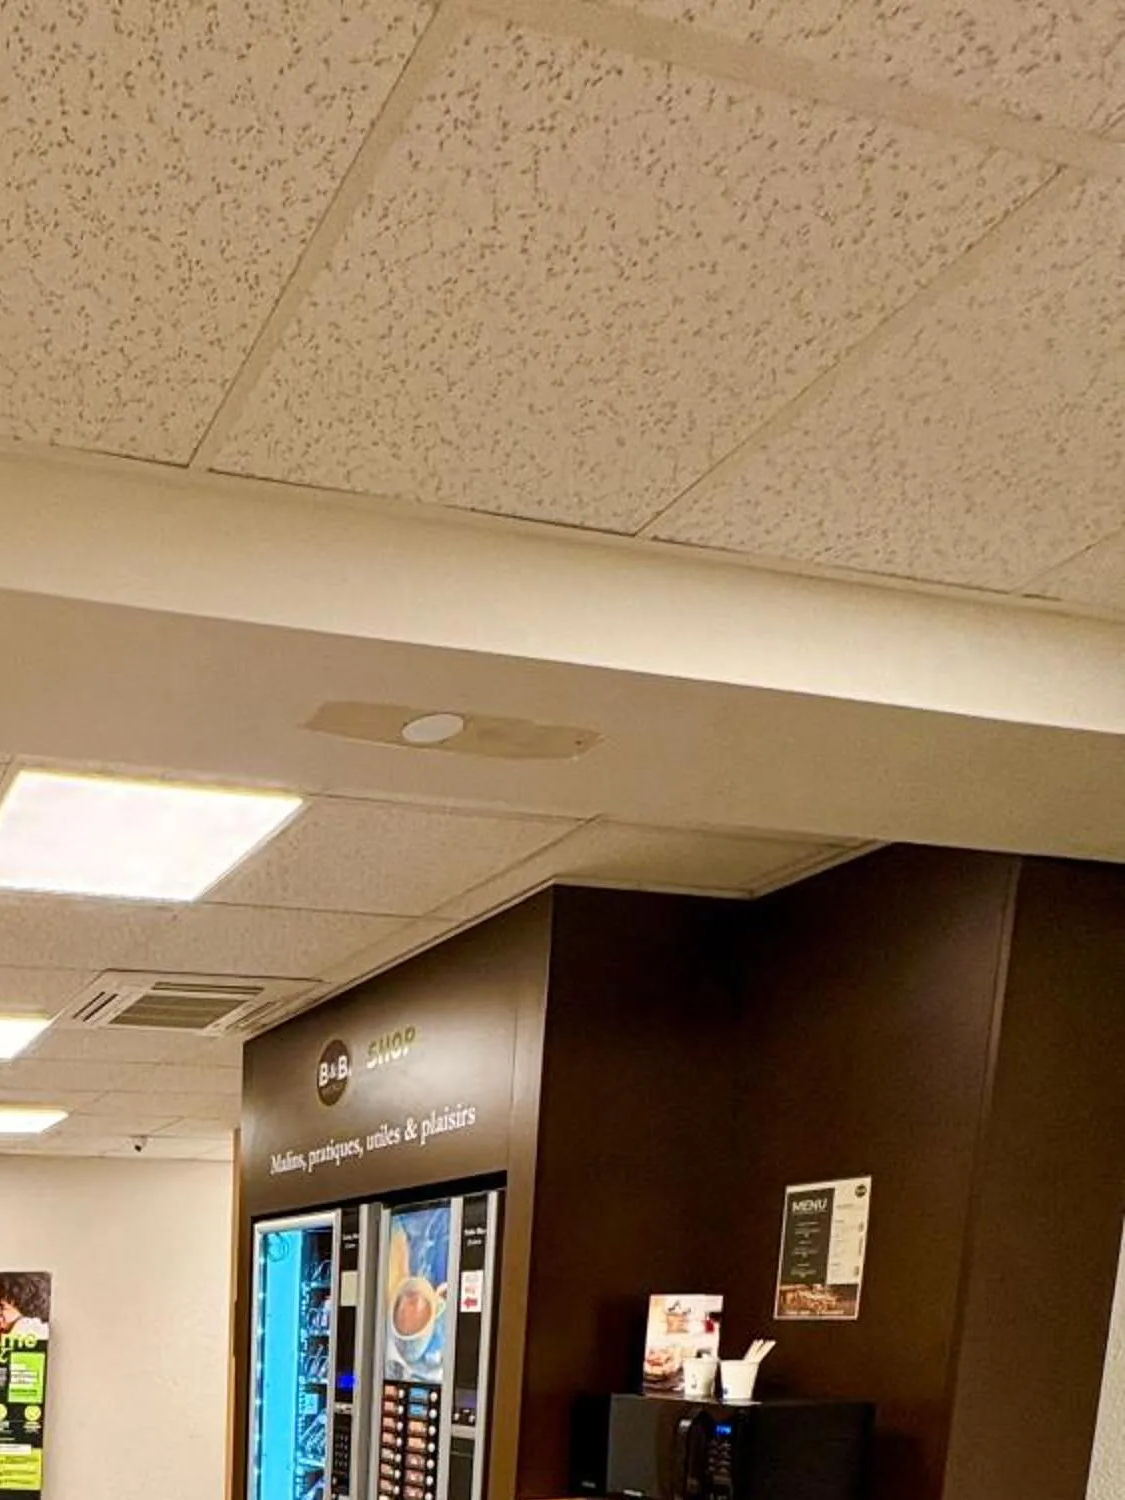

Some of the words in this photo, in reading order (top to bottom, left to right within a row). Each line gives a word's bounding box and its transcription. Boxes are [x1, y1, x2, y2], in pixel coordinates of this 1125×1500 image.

[366, 1026, 416, 1068] SHOP
[308, 1139, 364, 1174] pratiques,
[366, 1122, 401, 1151] utiles
[404, 1117, 418, 1141] &
[419, 1103, 476, 1145] plaisirs
[792, 1198, 828, 1213] MENU
